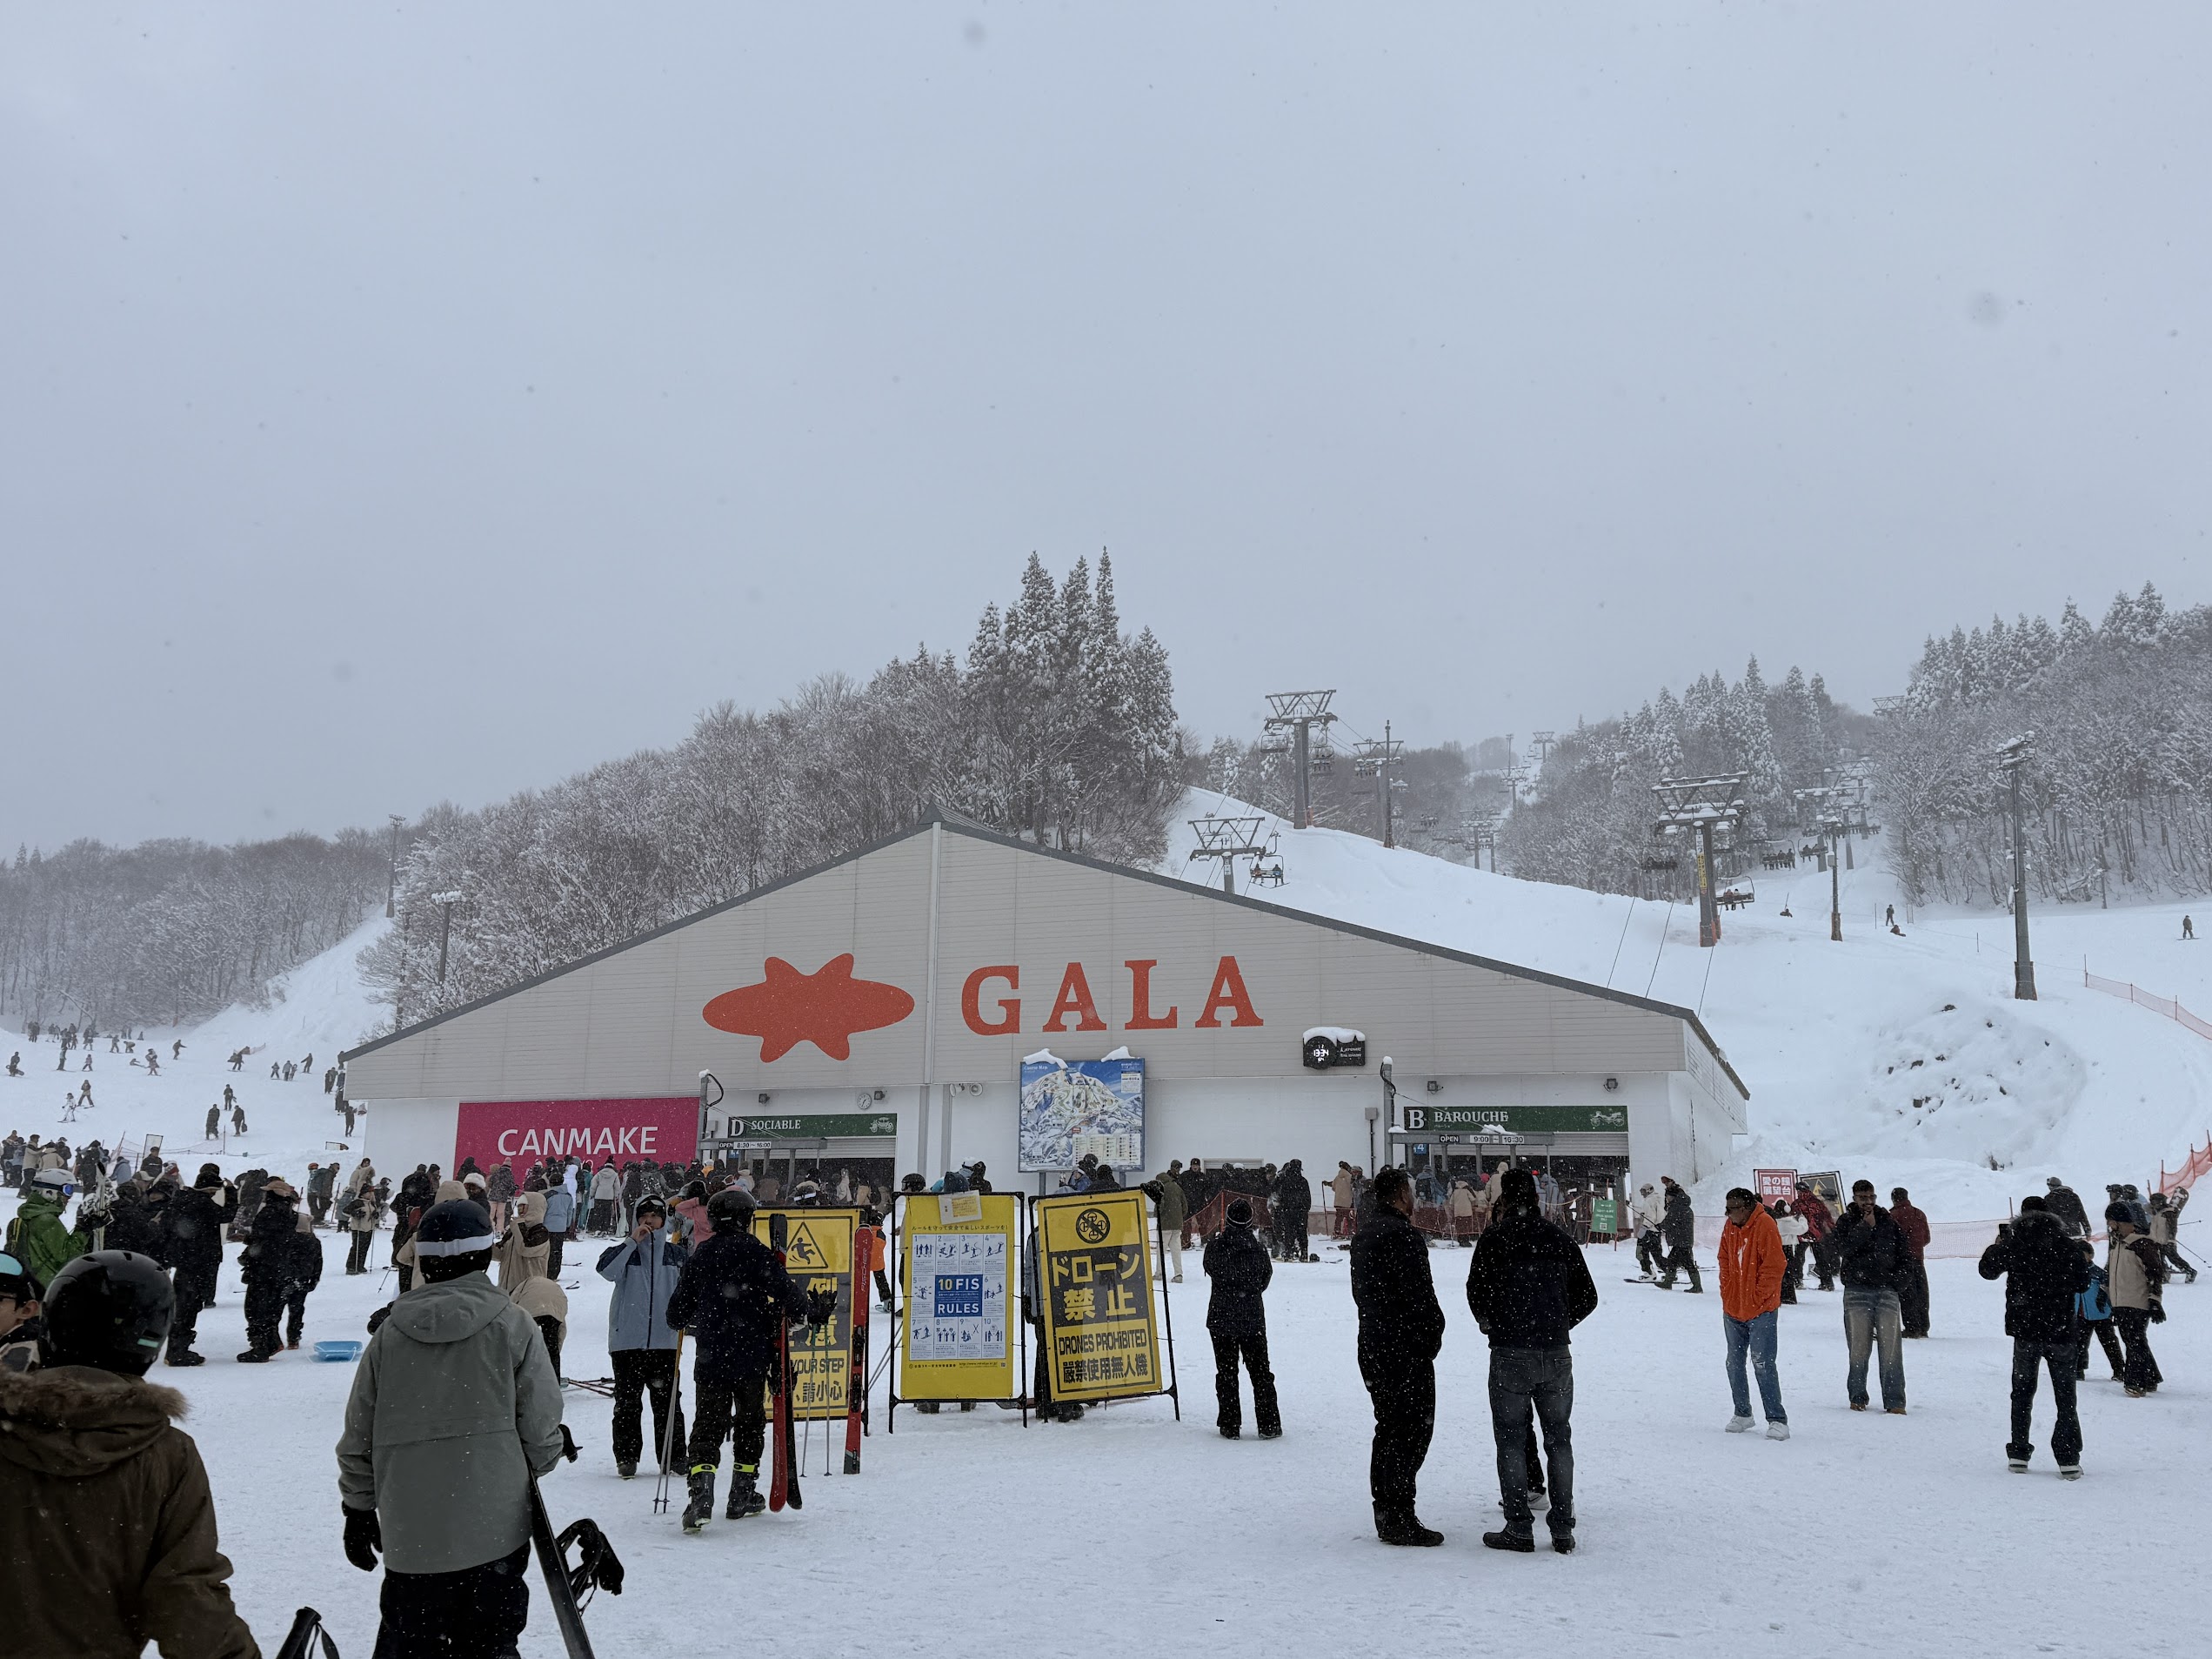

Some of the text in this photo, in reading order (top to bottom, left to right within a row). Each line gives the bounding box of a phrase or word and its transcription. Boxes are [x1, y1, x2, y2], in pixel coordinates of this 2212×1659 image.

[961, 956, 1264, 1036] GALA
[751, 1120, 801, 1130] SOCIABLE
[1408, 1109, 1425, 1129] B
[1434, 1111, 1508, 1122] BAROUCHE
[731, 1119, 745, 1137] D
[498, 1127, 658, 1156] CANMAKE
[1052, 1252, 1140, 1287] ドローン
[939, 1278, 979, 1291] 10 FIS
[939, 1303, 979, 1314] RULES
[1063, 1285, 1137, 1321] 禁止
[1059, 1335, 1094, 1355] DRONES
[791, 1358, 818, 1375] YOUR
[819, 1357, 845, 1375] STEP
